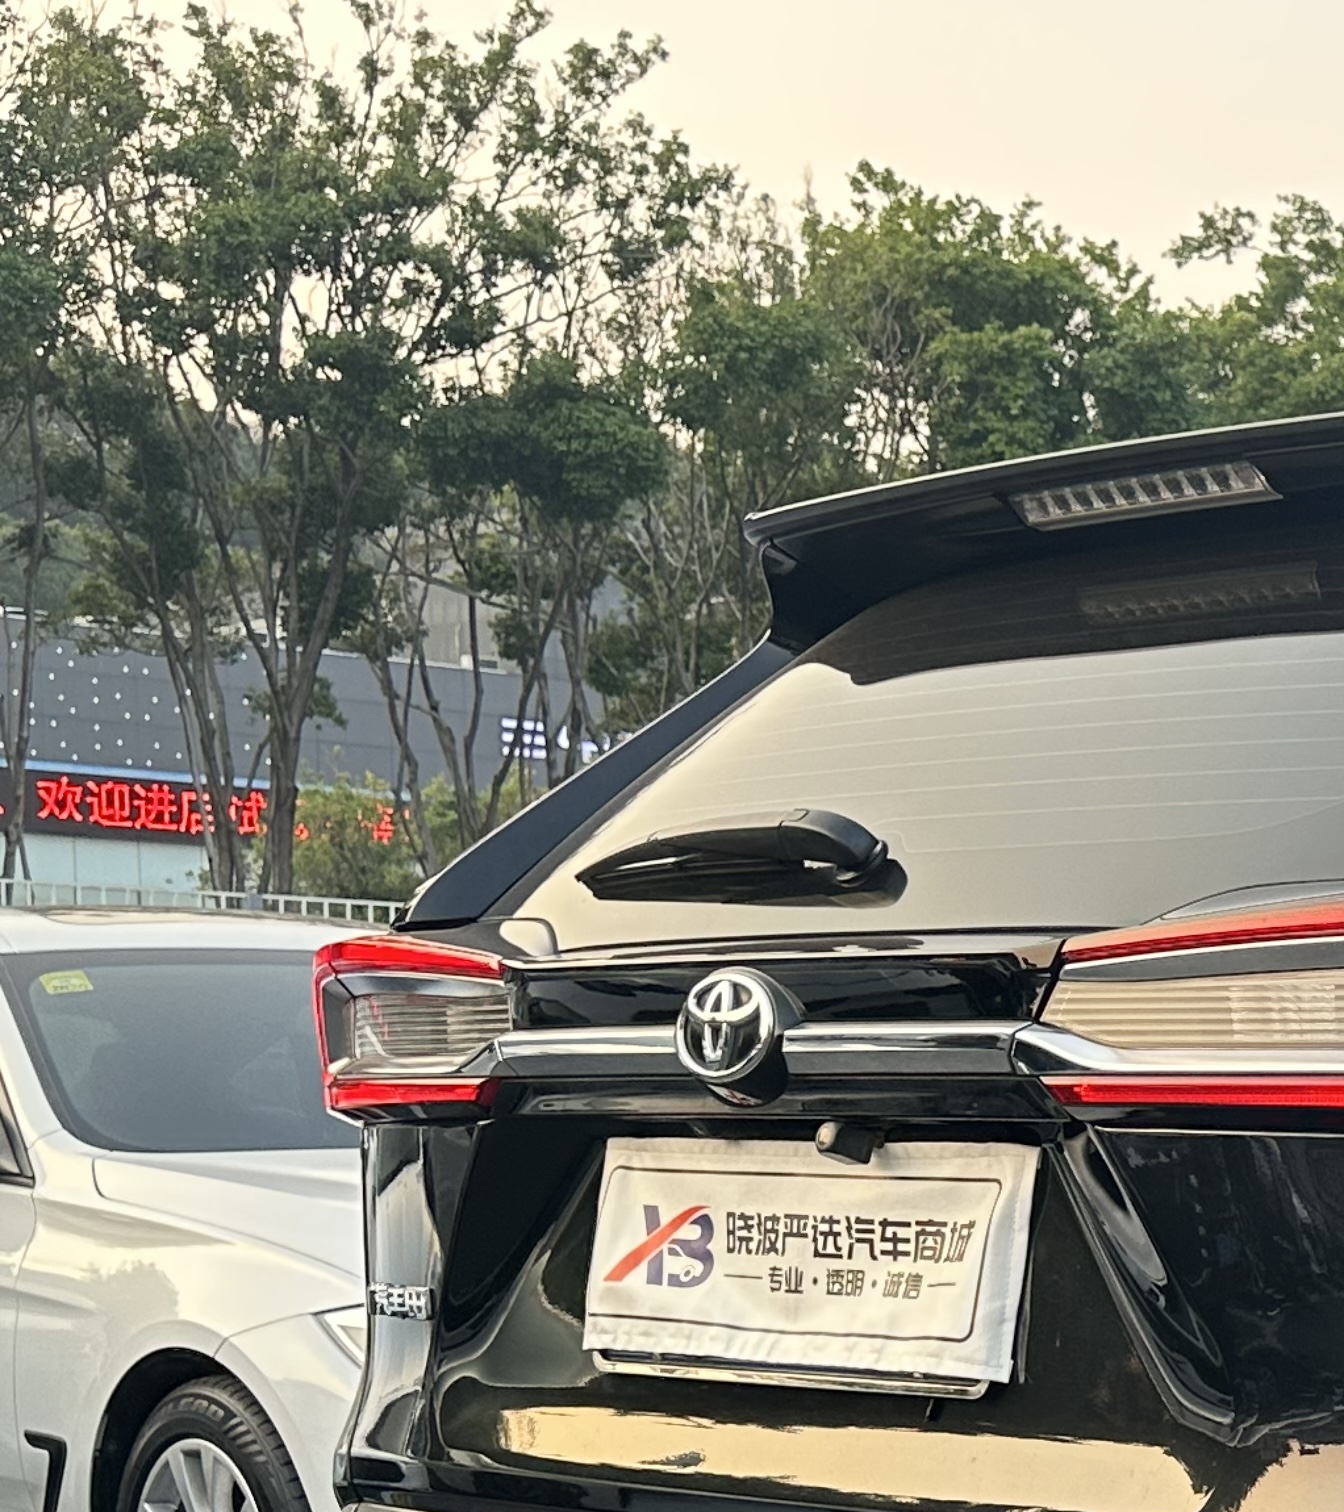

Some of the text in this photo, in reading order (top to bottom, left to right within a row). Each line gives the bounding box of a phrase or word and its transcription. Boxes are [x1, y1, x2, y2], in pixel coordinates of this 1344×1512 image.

[36, 774, 310, 840] 欢迎进店试
[725, 1210, 977, 1264] 晓波严选汽车商城
